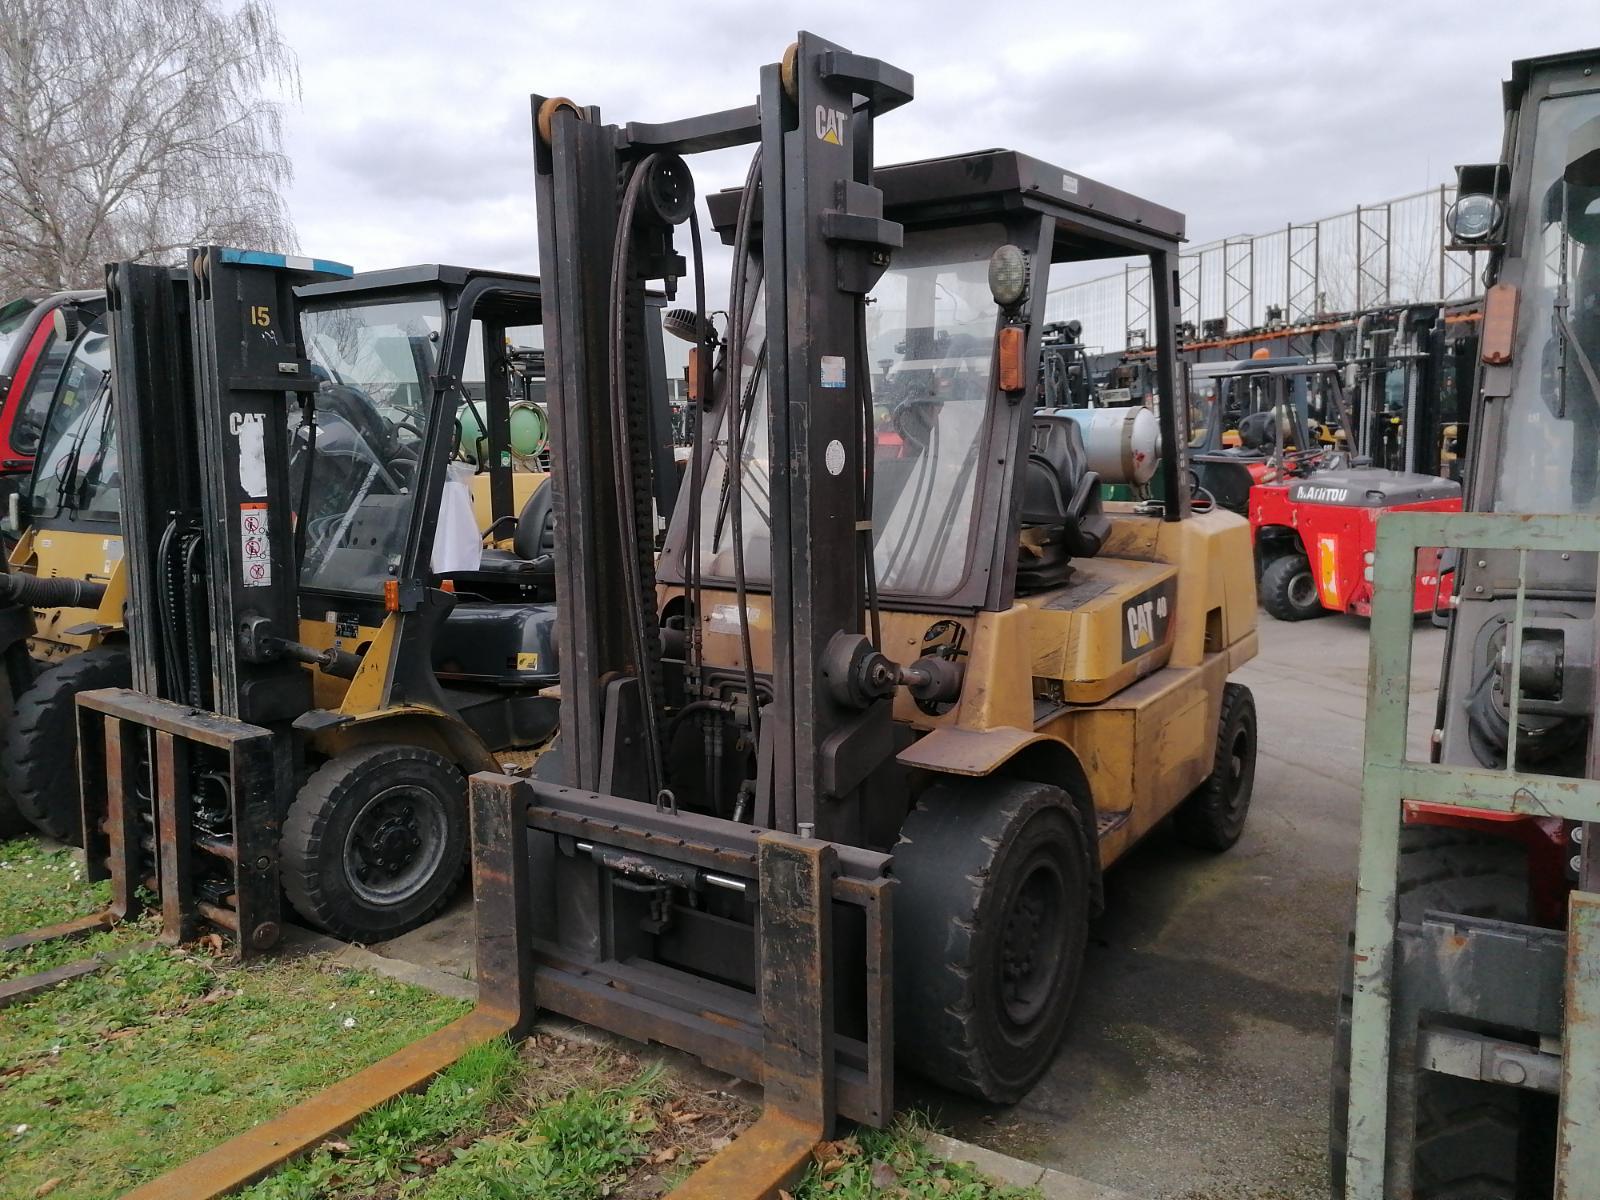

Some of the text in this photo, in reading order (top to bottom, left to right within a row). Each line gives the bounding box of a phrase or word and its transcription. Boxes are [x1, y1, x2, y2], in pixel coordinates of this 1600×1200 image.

[815, 104, 845, 146] CAT
[250, 305, 271, 327] 15
[1296, 486, 1348, 501] MANITOU
[1127, 596, 1168, 650] CAT 40
